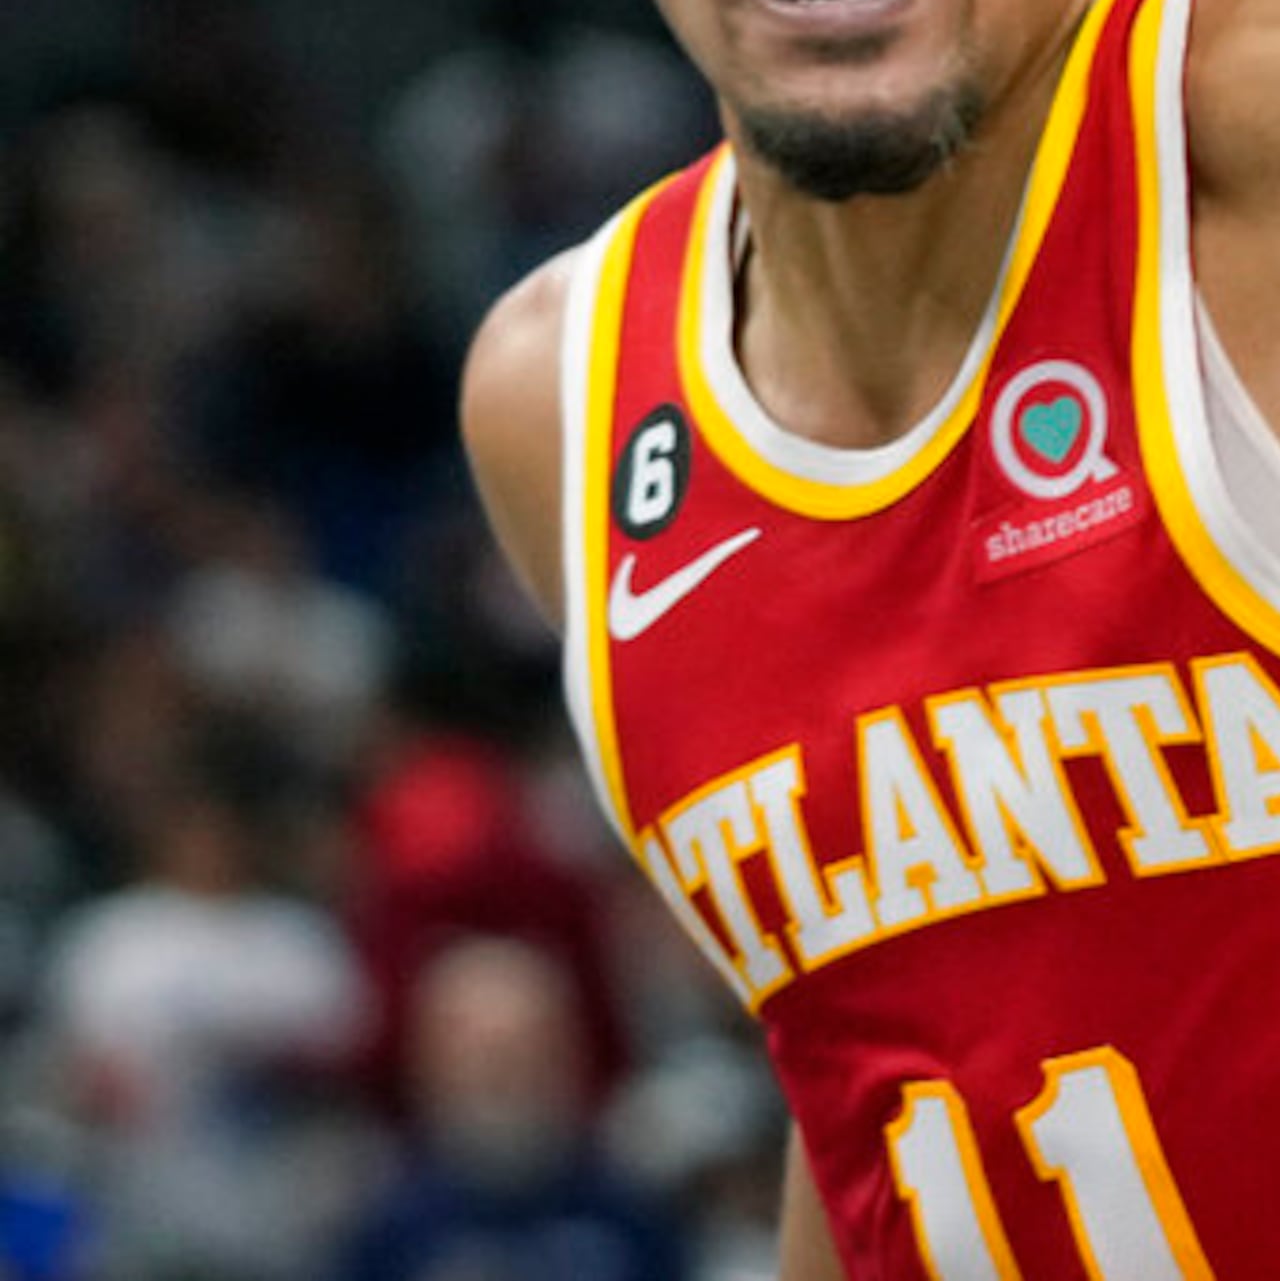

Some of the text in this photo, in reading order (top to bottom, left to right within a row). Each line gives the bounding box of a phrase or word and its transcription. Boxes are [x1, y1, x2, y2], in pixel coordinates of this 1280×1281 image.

[625, 417, 677, 526] 6
[986, 486, 1133, 562] sharecare
[886, 1044, 1216, 1281] 11
